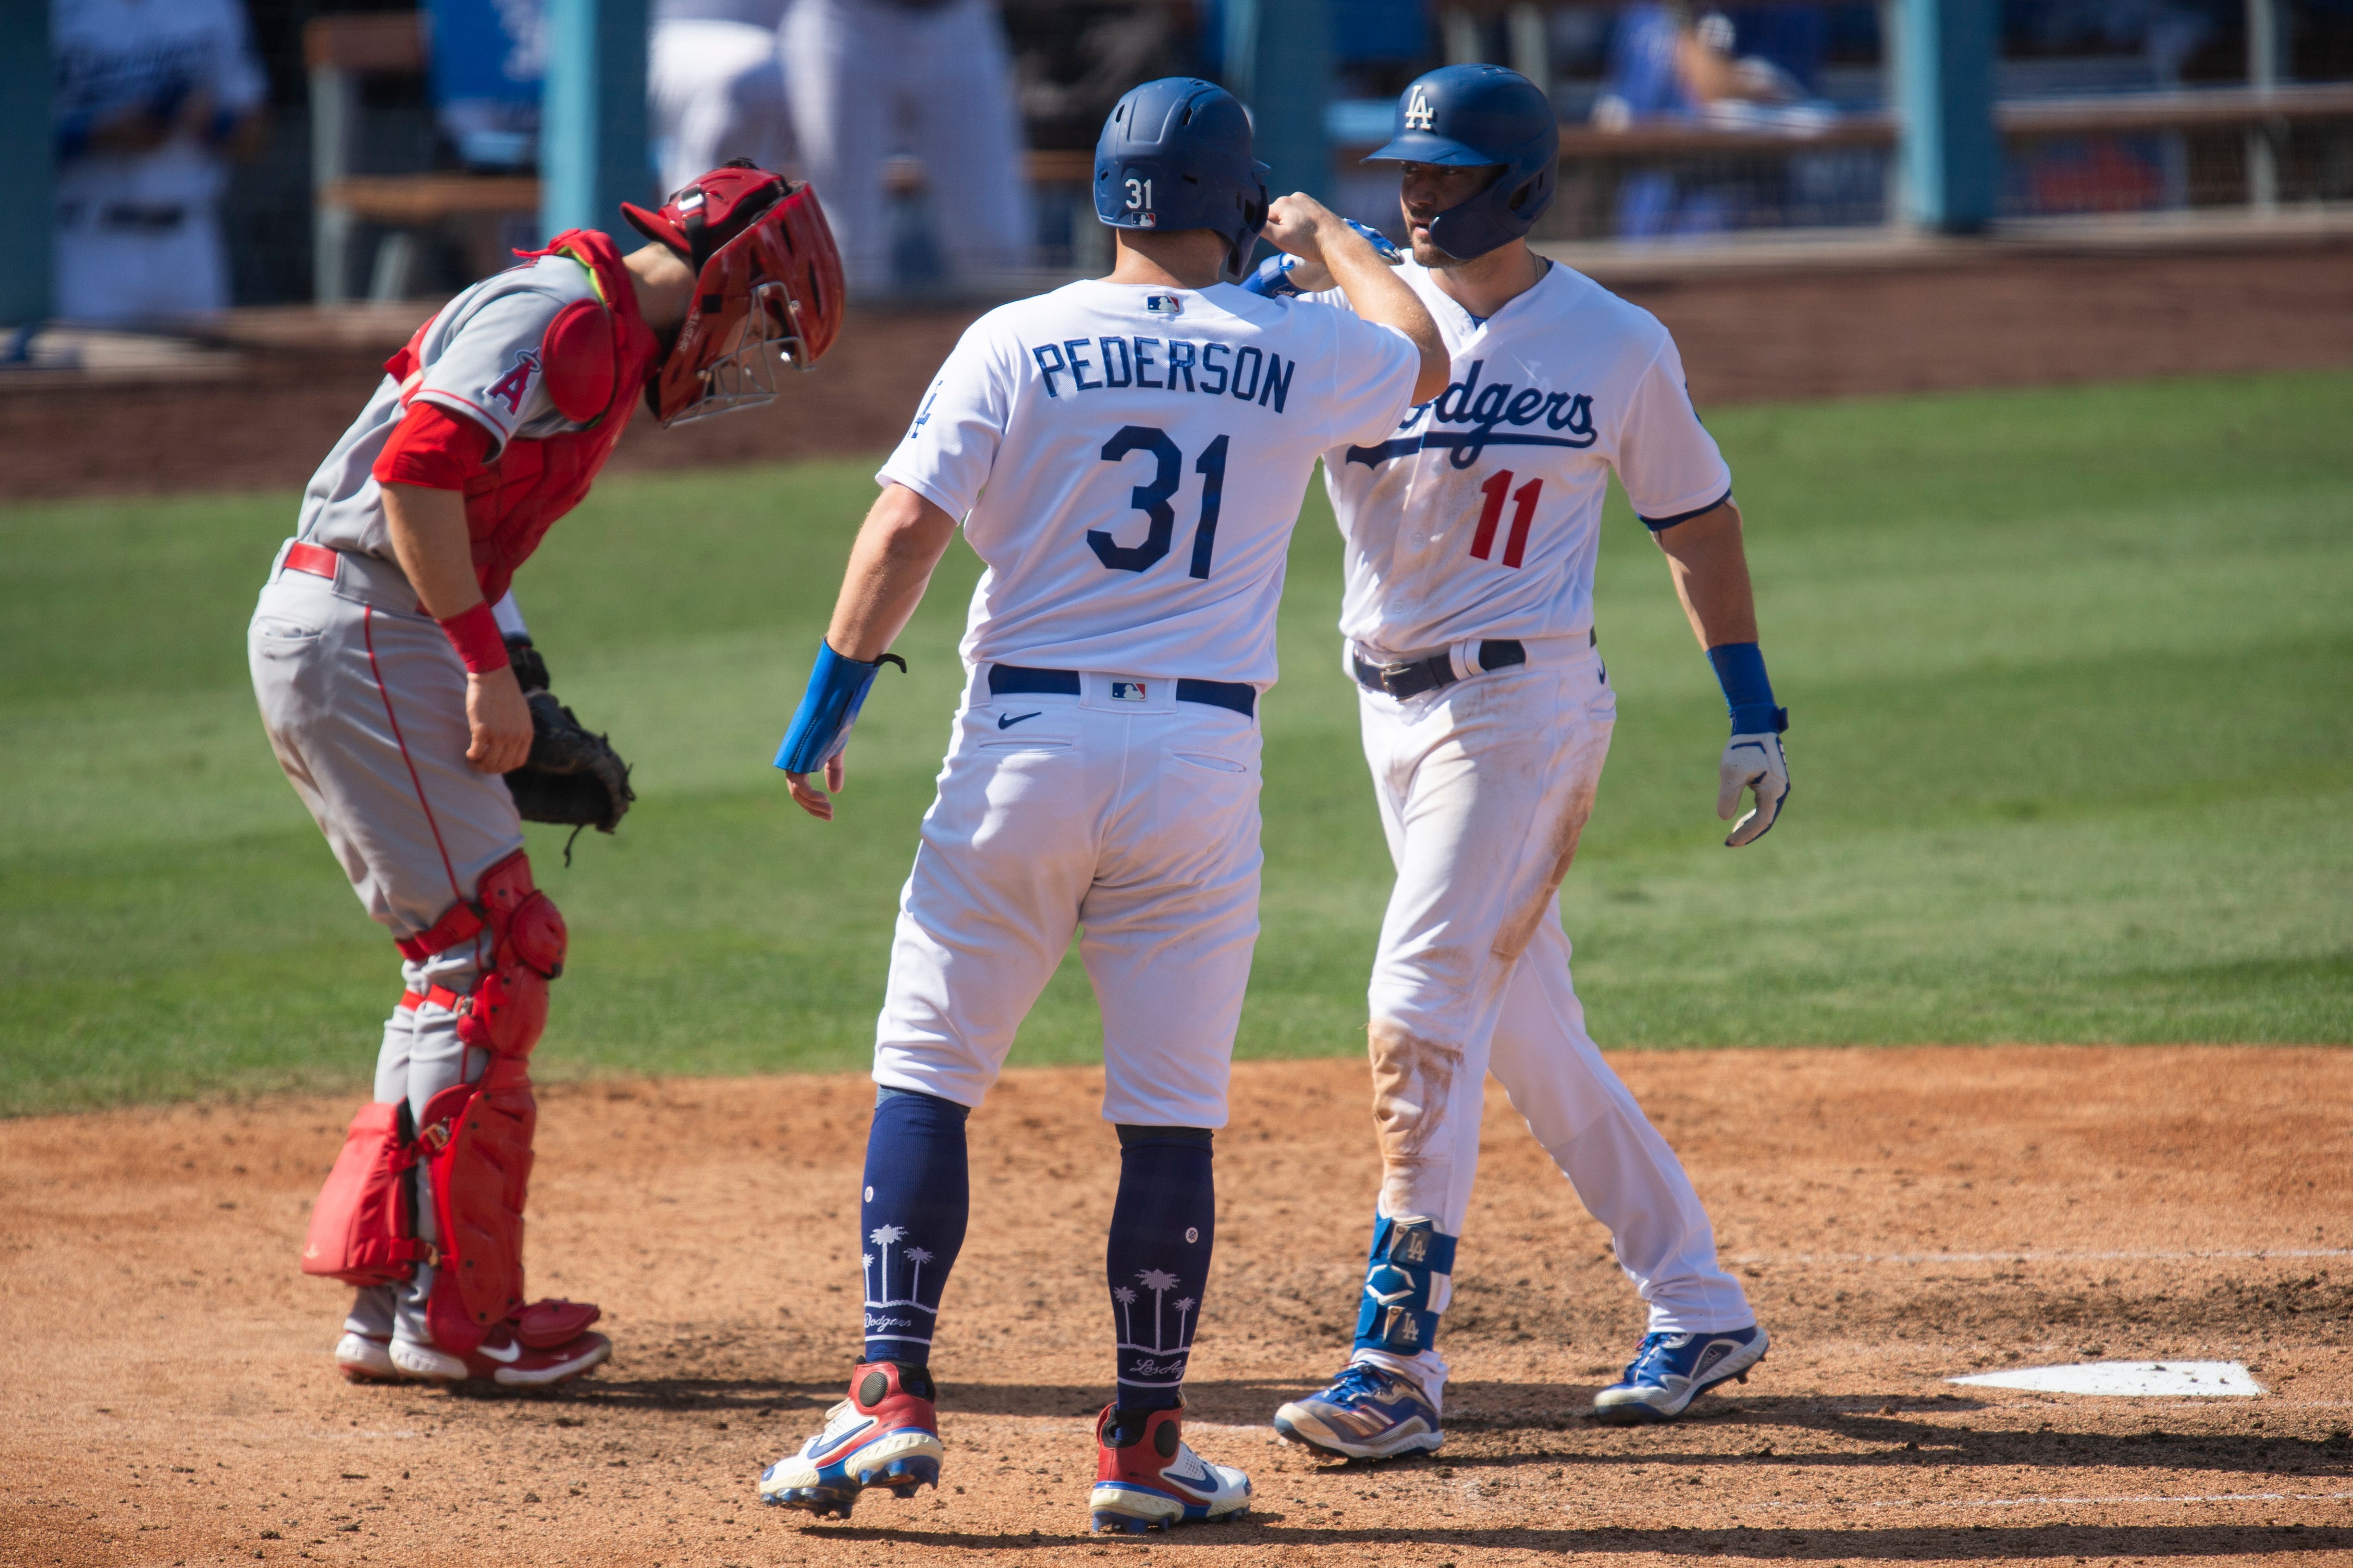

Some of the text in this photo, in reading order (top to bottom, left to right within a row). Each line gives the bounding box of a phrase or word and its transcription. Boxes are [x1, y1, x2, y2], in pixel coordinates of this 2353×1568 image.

[1405, 85, 1434, 129] LA
[1125, 178, 1151, 209] 31
[486, 346, 543, 418] A
[1032, 336, 1295, 413] PEDERSON
[1399, 359, 1598, 469] dgers
[1087, 425, 1230, 579] 31
[1469, 469, 1543, 568] 11
[1408, 1232, 1426, 1262] LA
[864, 1313, 911, 1332] Dodgers
[1402, 1312, 1419, 1341] LA
